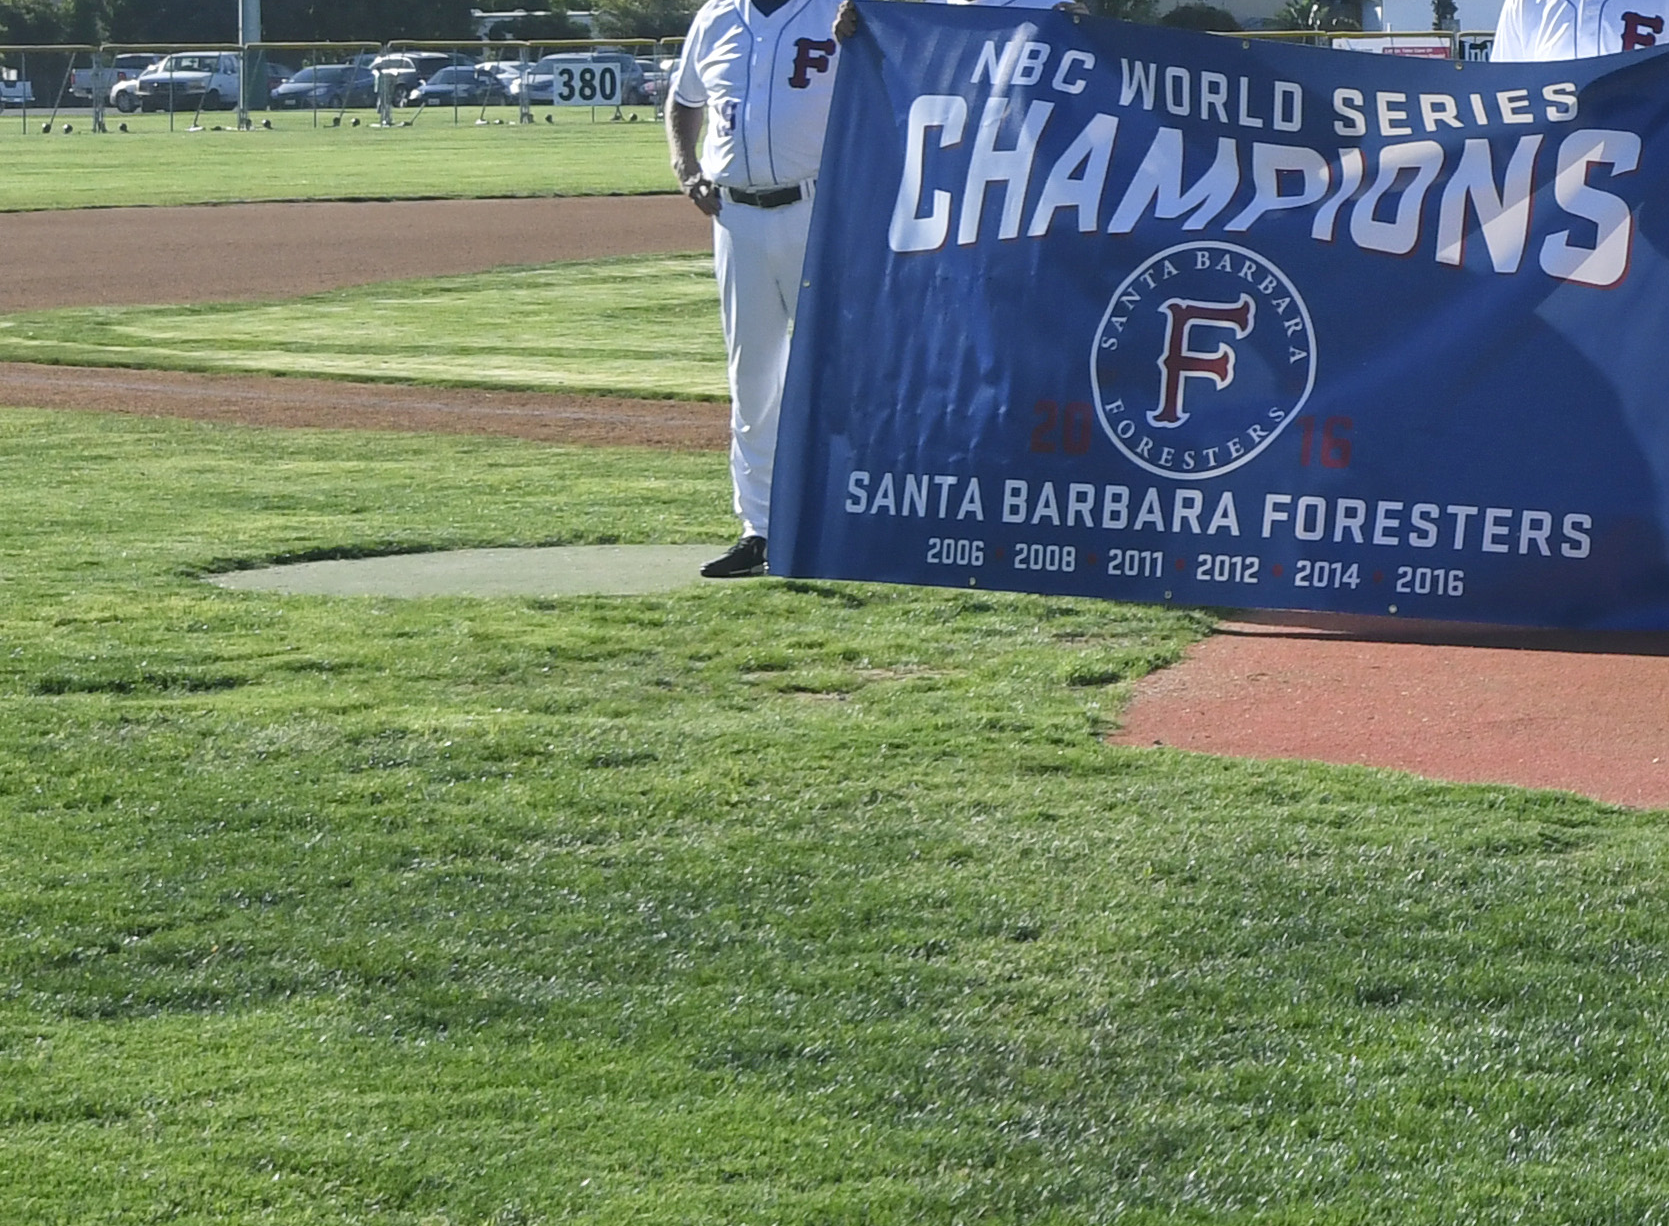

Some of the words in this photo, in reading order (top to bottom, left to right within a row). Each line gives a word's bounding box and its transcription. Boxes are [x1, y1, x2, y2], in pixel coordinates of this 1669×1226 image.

[558, 67, 617, 102] 380
[788, 37, 836, 89] F
[971, 39, 1096, 95] NBC
[1120, 57, 1302, 132] WORLD
[1334, 81, 1579, 137] SERIES
[888, 94, 1643, 288] CHAMPIONS
[1101, 258, 1180, 351] SANTA
[1195, 250, 1308, 365] BARBARA
[1146, 292, 1257, 429] F
[1030, 399, 1095, 456] 20
[1295, 415, 1354, 470] 16
[1105, 398, 1286, 470] FORESTERS
[844, 469, 985, 522] SANTA
[1000, 479, 1241, 538] BARBARA
[1261, 493, 1593, 560] FORESTERS
[926, 537, 985, 567] 2006
[1013, 543, 1076, 573] 2008
[1107, 548, 1164, 578] 2011
[1196, 554, 1260, 585] 2012
[1294, 559, 1361, 590] 2014
[1395, 566, 1465, 598] 2016
